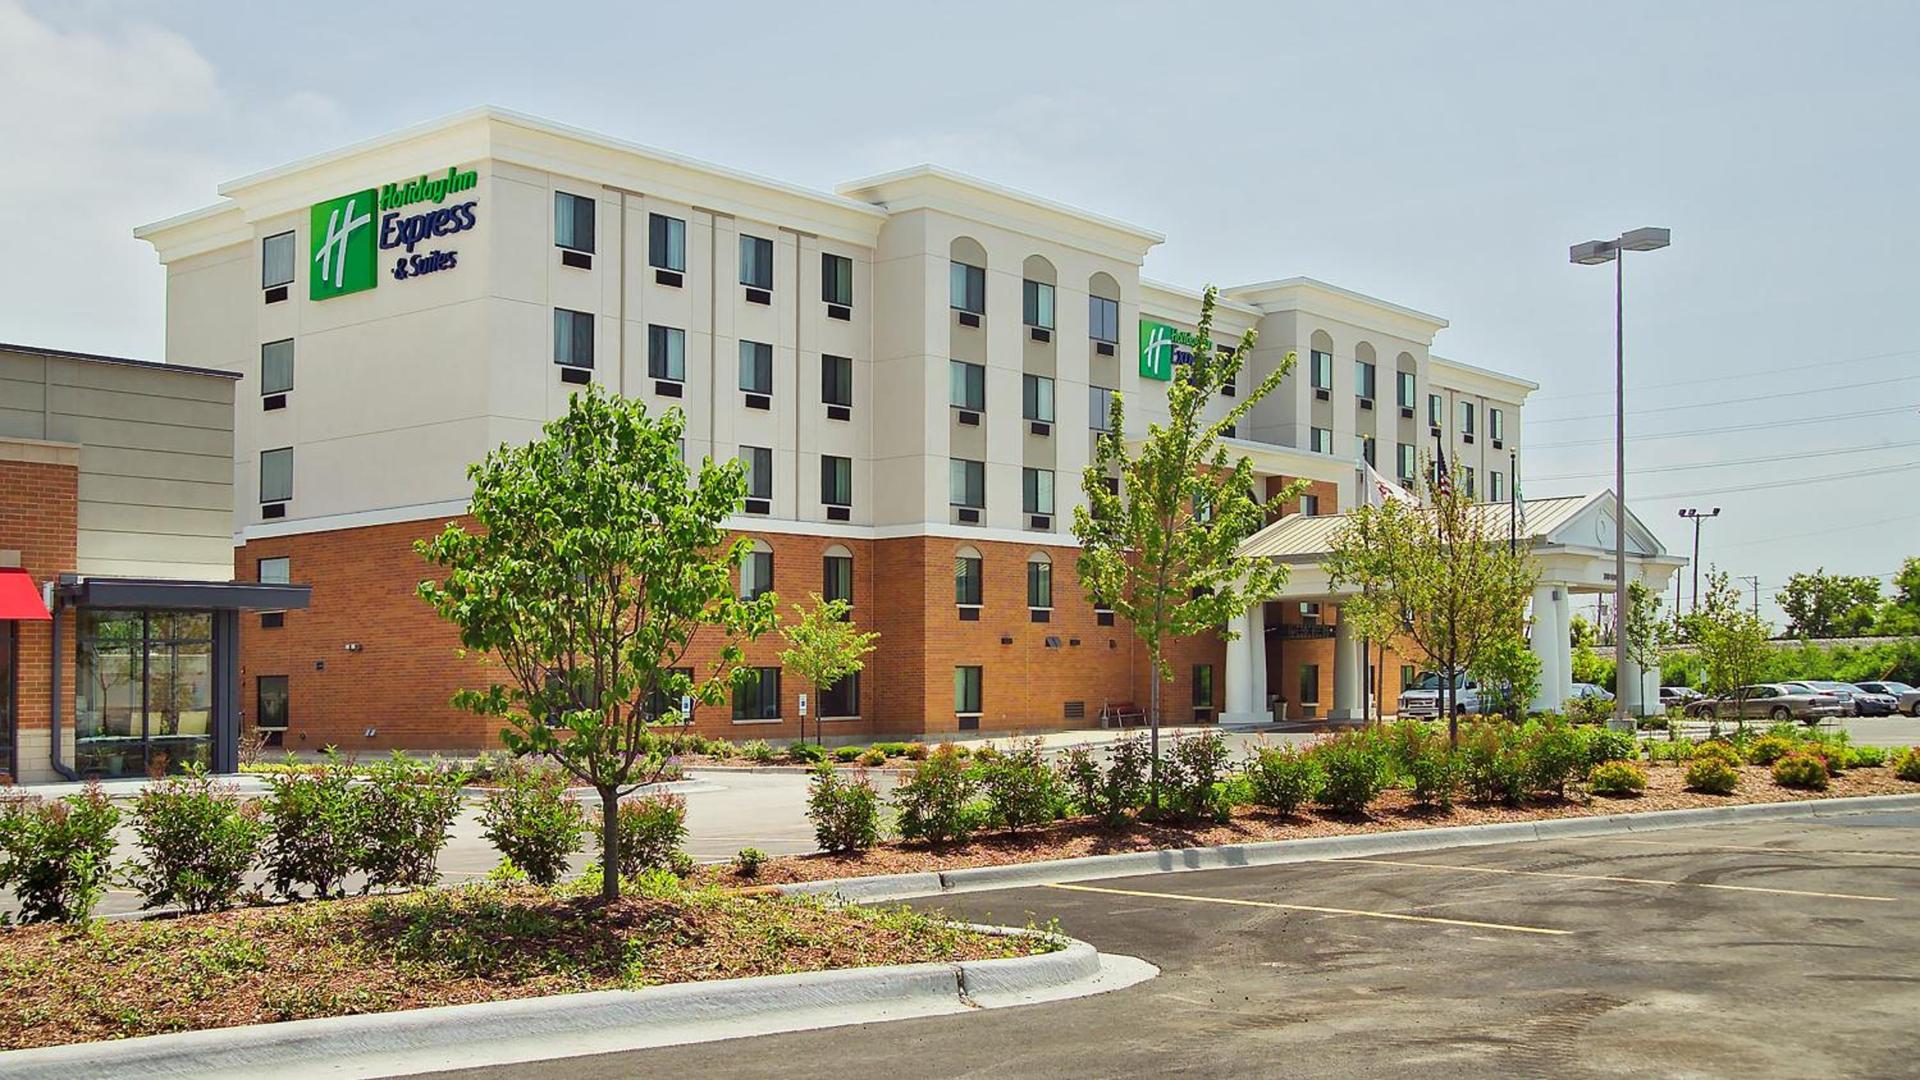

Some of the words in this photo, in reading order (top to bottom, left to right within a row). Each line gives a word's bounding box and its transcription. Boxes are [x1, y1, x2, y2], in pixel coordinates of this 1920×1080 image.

[379, 175, 449, 211] Holiday
[447, 166, 478, 194] Inn
[379, 201, 478, 253] Express
[408, 249, 458, 277] Suites
